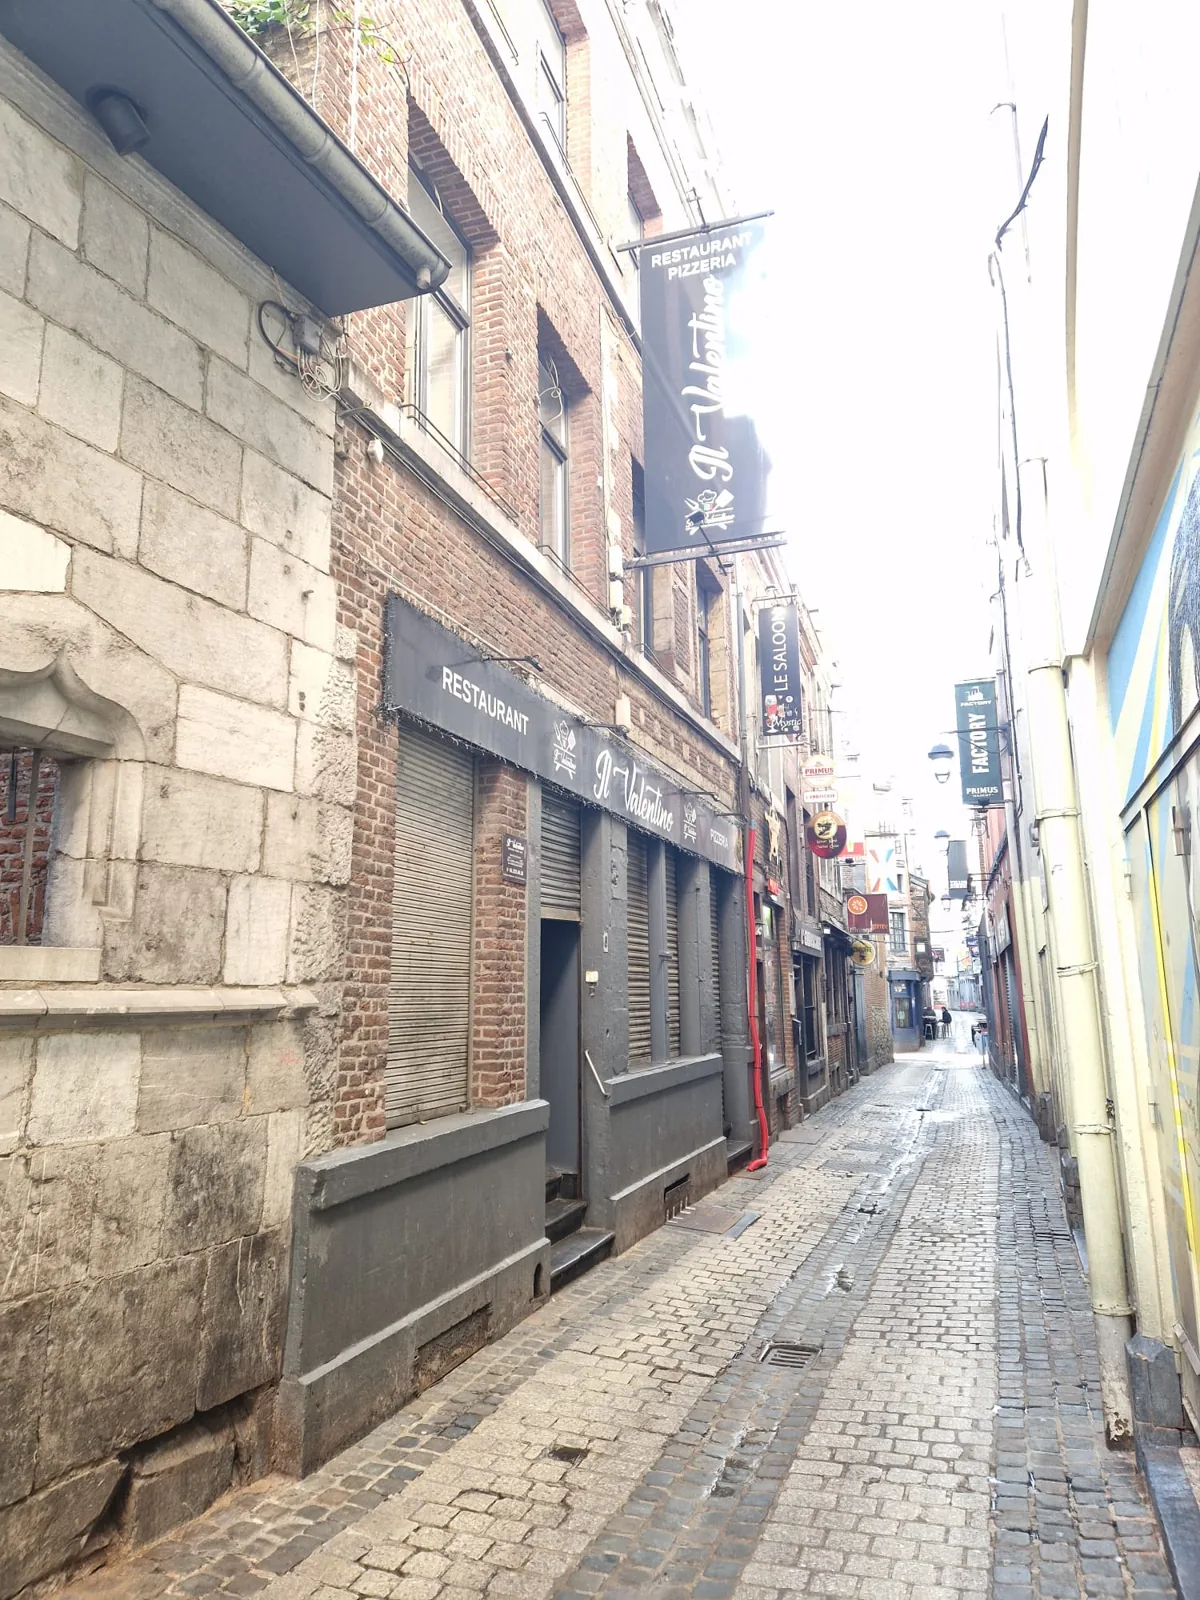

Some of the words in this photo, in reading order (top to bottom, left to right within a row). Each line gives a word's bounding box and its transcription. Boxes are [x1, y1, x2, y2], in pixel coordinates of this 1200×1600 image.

[651, 231, 753, 268] RESTAURANT
[668, 252, 737, 281] PIZZERIA
[681, 274, 726, 441] Valentino
[774, 674, 789, 692] LE
[442, 665, 530, 736] RESTAURANT
[968, 713, 990, 774] FACTORY
[804, 767, 834, 775] PRIMUS
[593, 749, 612, 800] Il
[613, 760, 674, 832] Valentino
[966, 786, 998, 795] PRIMUS
[710, 828, 729, 850] PIZZERIA
